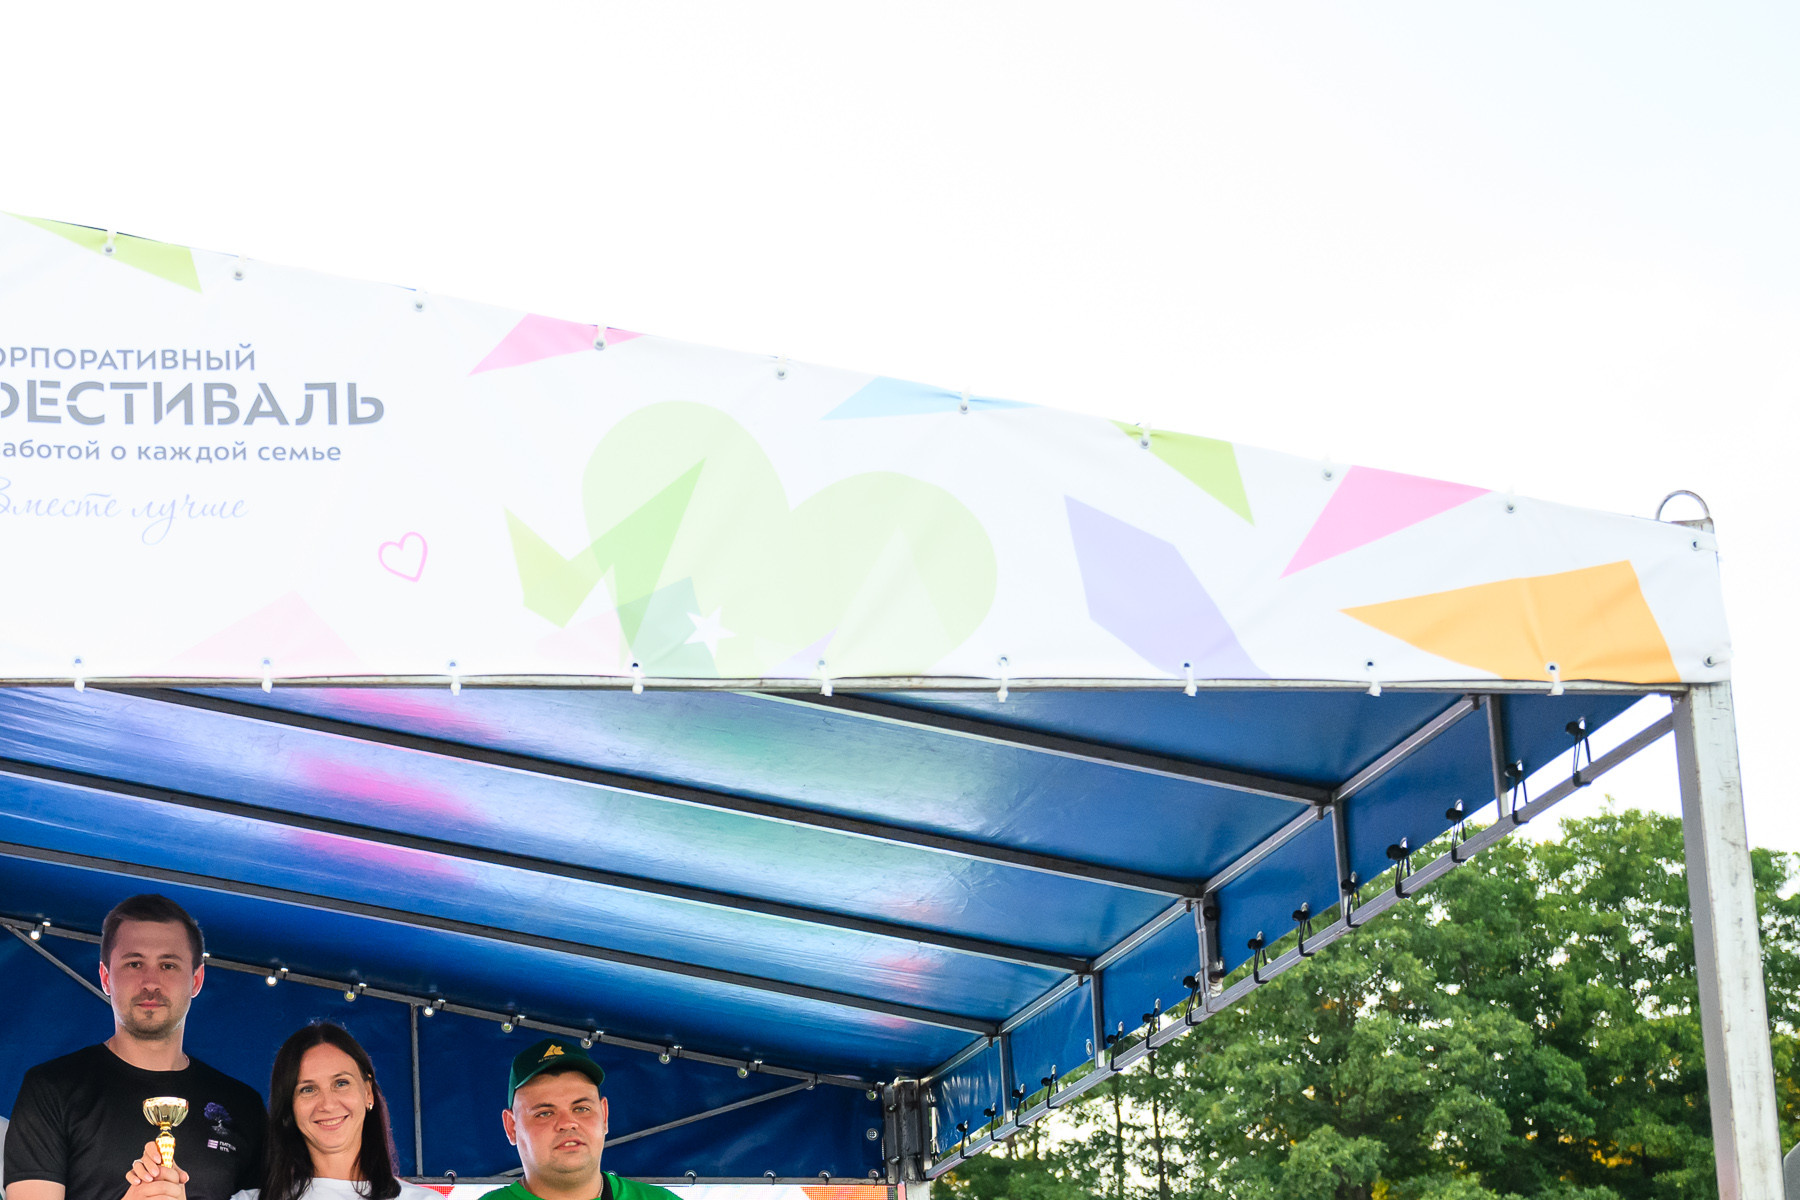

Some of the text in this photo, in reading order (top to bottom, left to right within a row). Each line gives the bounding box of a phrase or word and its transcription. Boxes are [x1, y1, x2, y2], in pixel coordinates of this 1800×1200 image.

[111, 445, 127, 461] о
[137, 441, 247, 464] каждой
[257, 445, 342, 461] семье
[130, 494, 249, 546] лучше
